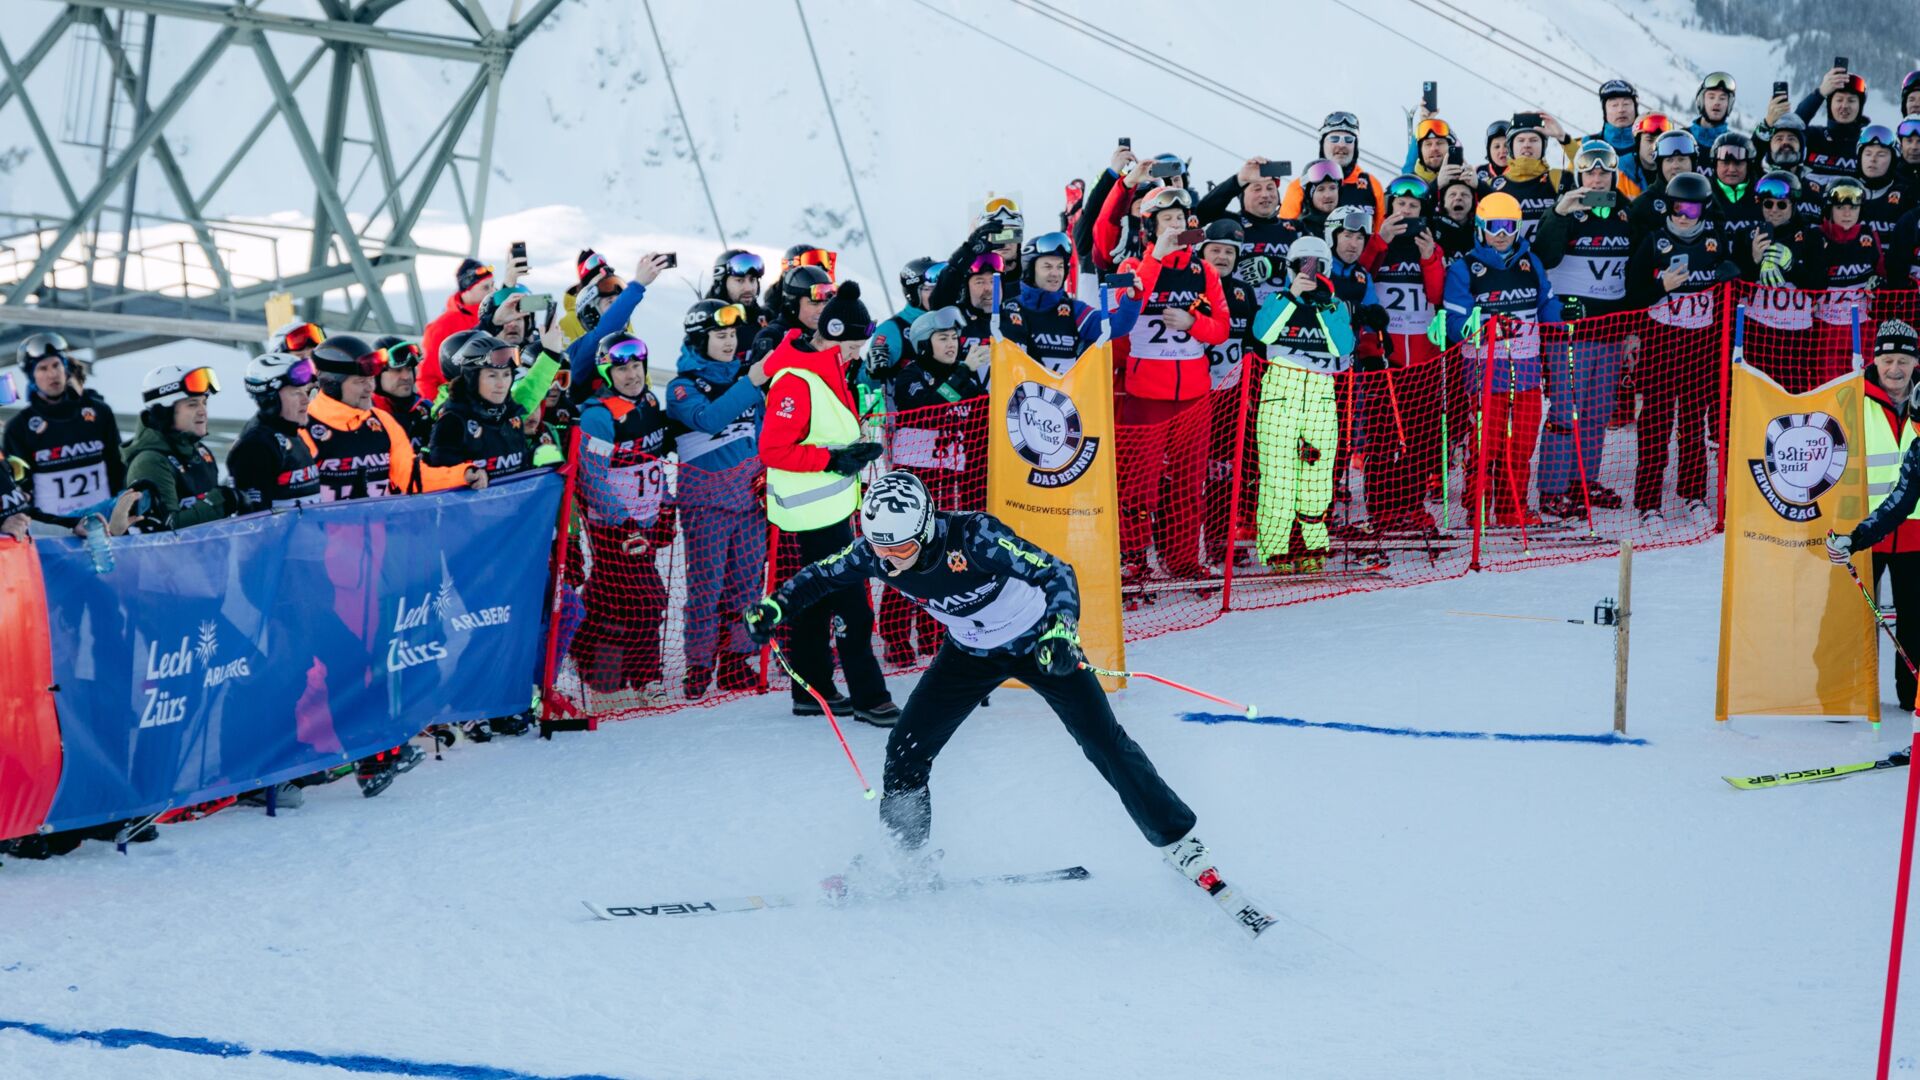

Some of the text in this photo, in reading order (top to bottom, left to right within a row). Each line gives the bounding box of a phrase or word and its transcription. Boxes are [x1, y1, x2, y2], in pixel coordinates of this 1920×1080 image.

[1815, 154, 1858, 170] REM
[1576, 236, 1630, 247] REMU
[1475, 287, 1538, 303] REMUS
[35, 440, 105, 463] REMUS
[1032, 441, 1097, 486] DAS RENNEN
[53, 469, 101, 499] 121
[634, 464, 661, 498] 19
[918, 581, 998, 611] MUS
[393, 592, 512, 633] Lech ARLBERG
[146, 636, 250, 688] Lech ARLRG
[387, 637, 448, 672] Zürs
[139, 688, 188, 729] Zürs
[1748, 767, 1835, 784] FISCHER
[607, 902, 717, 917] HEAD
